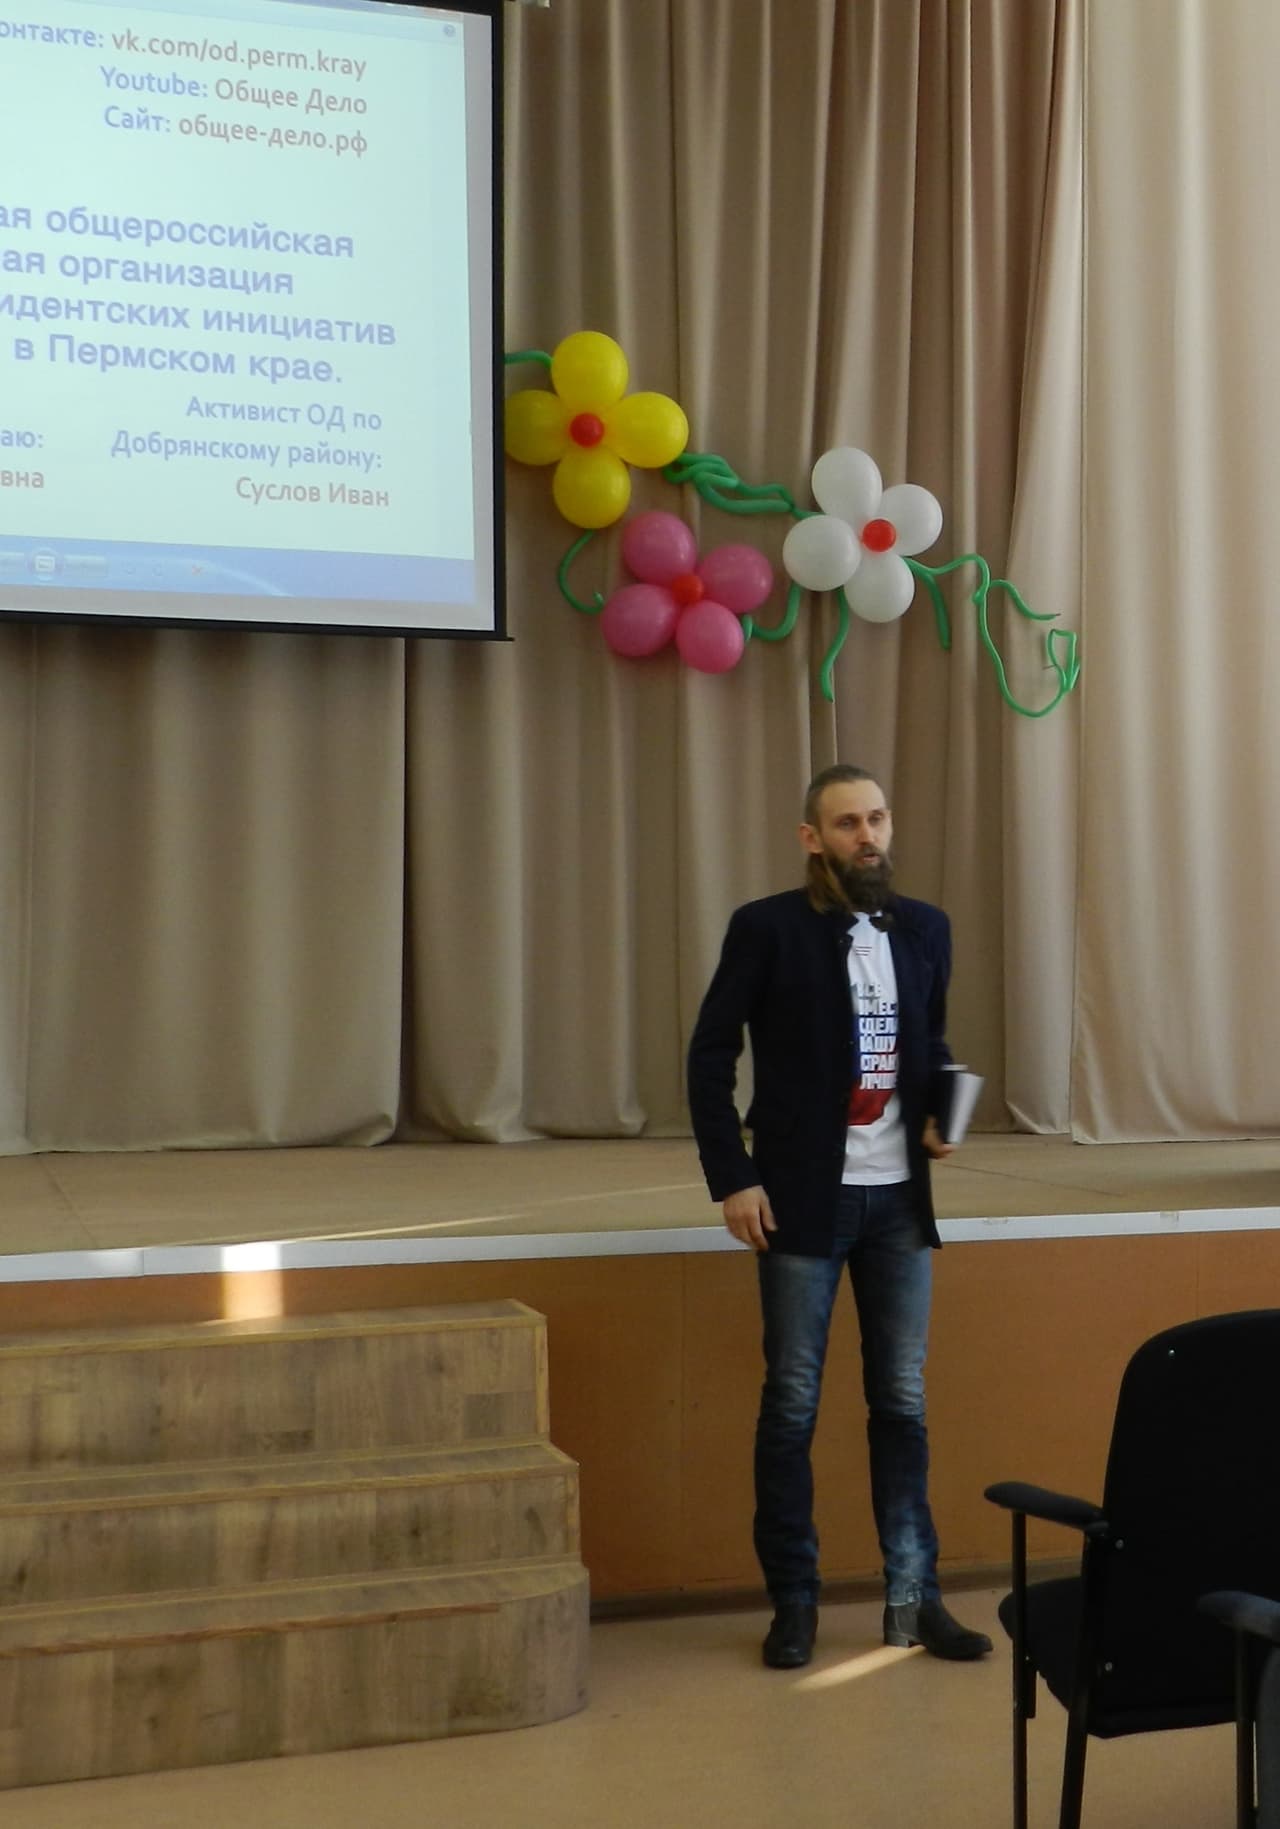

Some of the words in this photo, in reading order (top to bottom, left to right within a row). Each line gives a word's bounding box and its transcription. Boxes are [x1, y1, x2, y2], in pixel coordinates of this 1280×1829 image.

[112, 28, 367, 80] vk.com/od.perm.kray
[99, 65, 209, 99] Youtube:
[214, 78, 299, 108] Общее
[305, 88, 368, 116] Дело
[103, 105, 171, 133] Сайт:
[179, 116, 368, 157] общее-дело.рф
[46, 206, 354, 258] общероссийская
[59, 254, 294, 295] организация
[202, 308, 397, 345] инициатив
[14, 337, 35, 361] в
[49, 333, 236, 373] Пермском
[249, 354, 342, 385] крае.
[186, 396, 302, 424] Активист
[307, 403, 346, 431] ОД
[352, 411, 383, 431] по
[111, 430, 281, 468] Добрянскому
[287, 444, 383, 474] району:
[235, 476, 321, 504] Суслов
[328, 481, 390, 507] Иван
